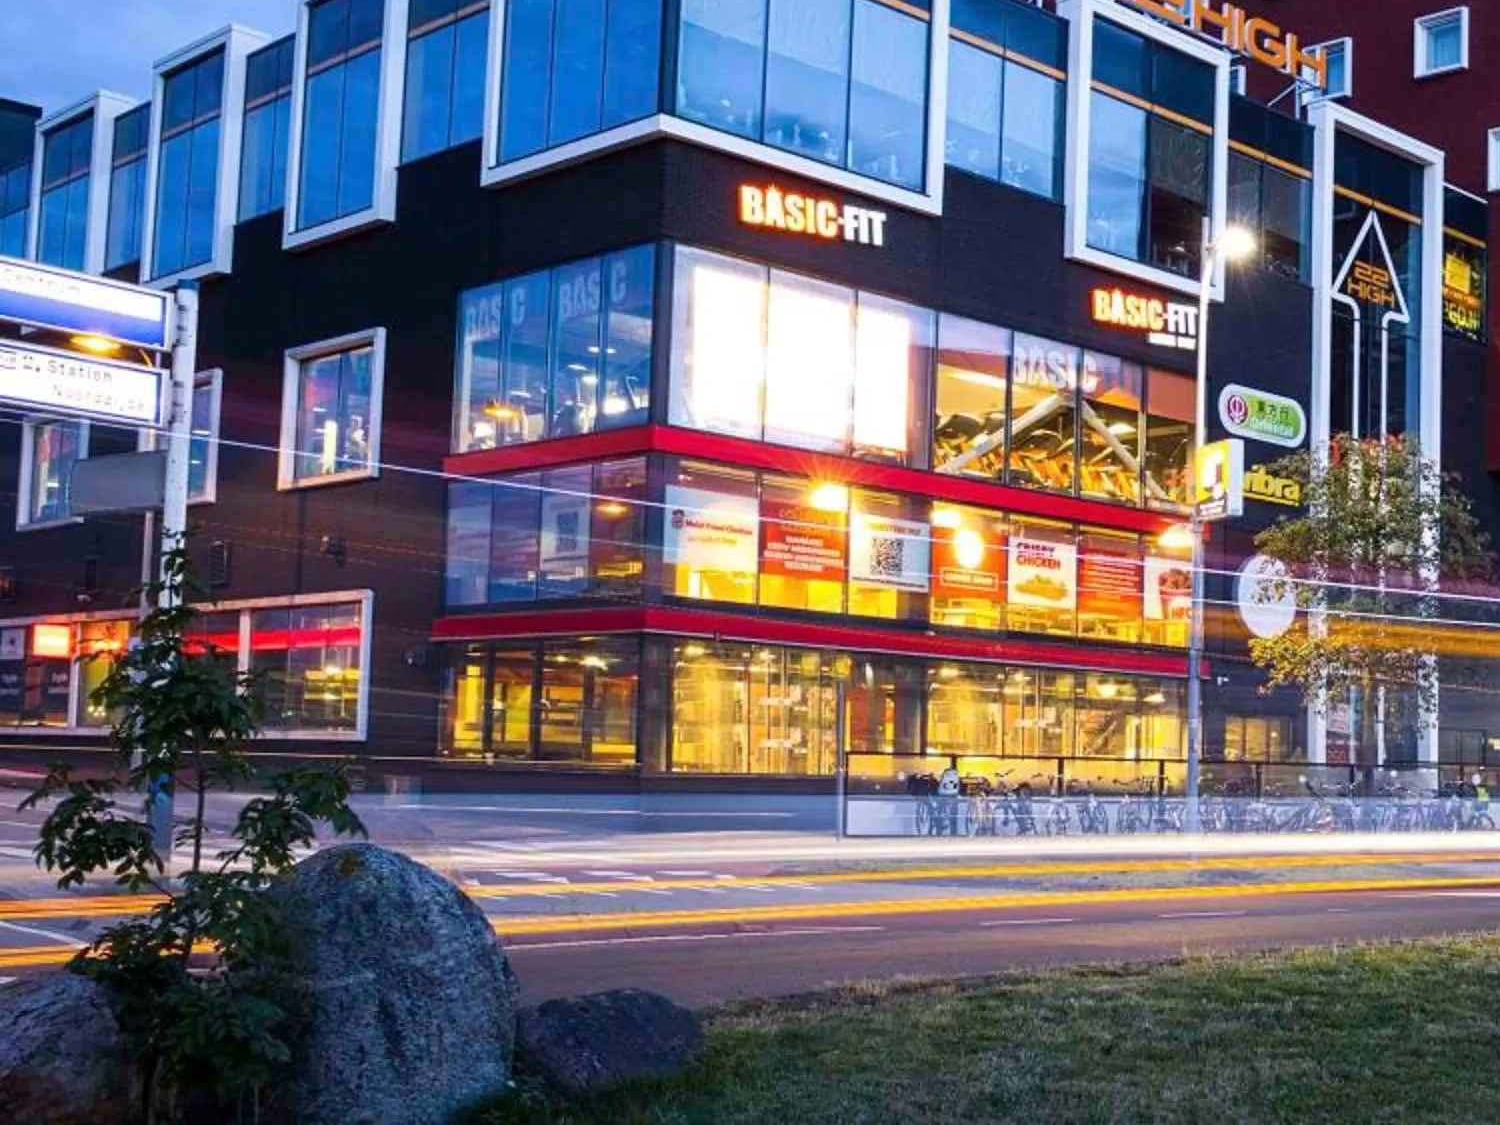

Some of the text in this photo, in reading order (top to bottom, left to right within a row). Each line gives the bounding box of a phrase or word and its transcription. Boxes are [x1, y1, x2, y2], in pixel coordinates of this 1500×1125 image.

[1354, 259, 1390, 290] 22
[1346, 277, 1396, 309] HIGH
[47, 359, 113, 383] Station
